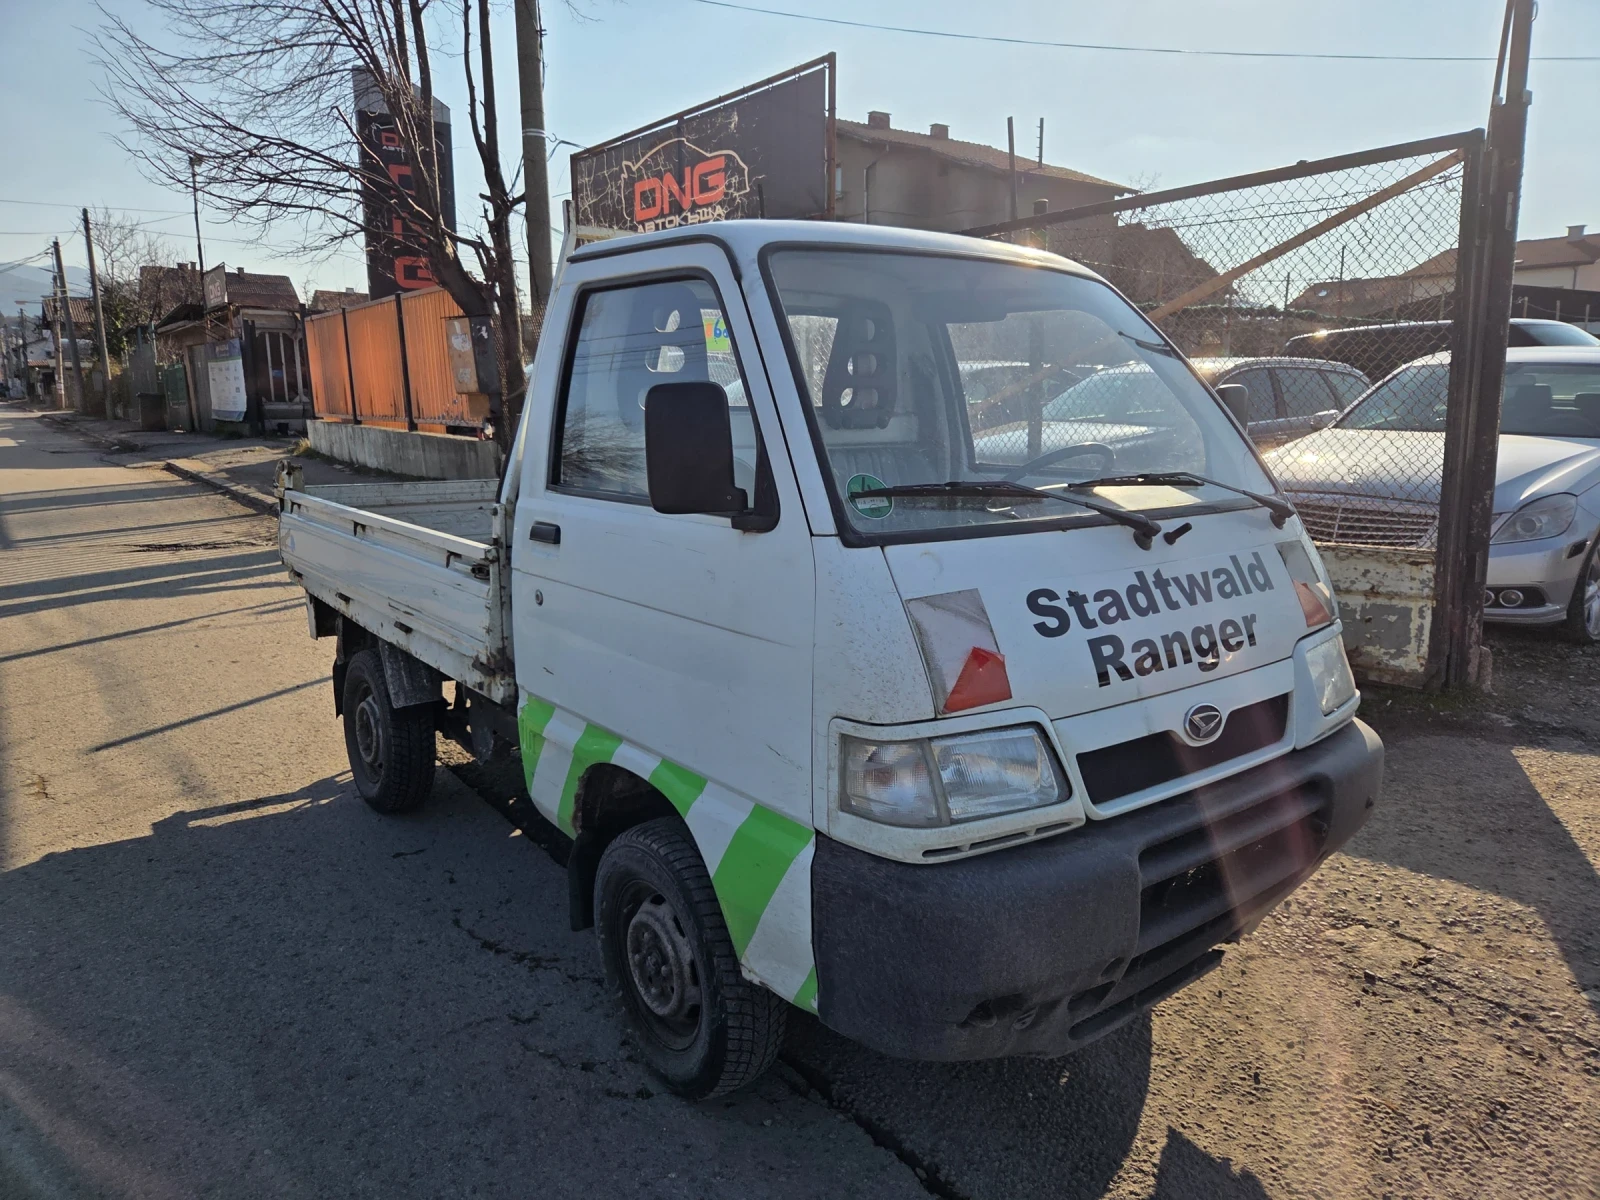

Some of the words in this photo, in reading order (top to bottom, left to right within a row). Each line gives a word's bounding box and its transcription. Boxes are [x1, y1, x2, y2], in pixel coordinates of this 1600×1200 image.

[634, 156, 725, 222] DNG
[1026, 552, 1275, 638] Stadtwald
[1086, 613, 1257, 688] Ranger
